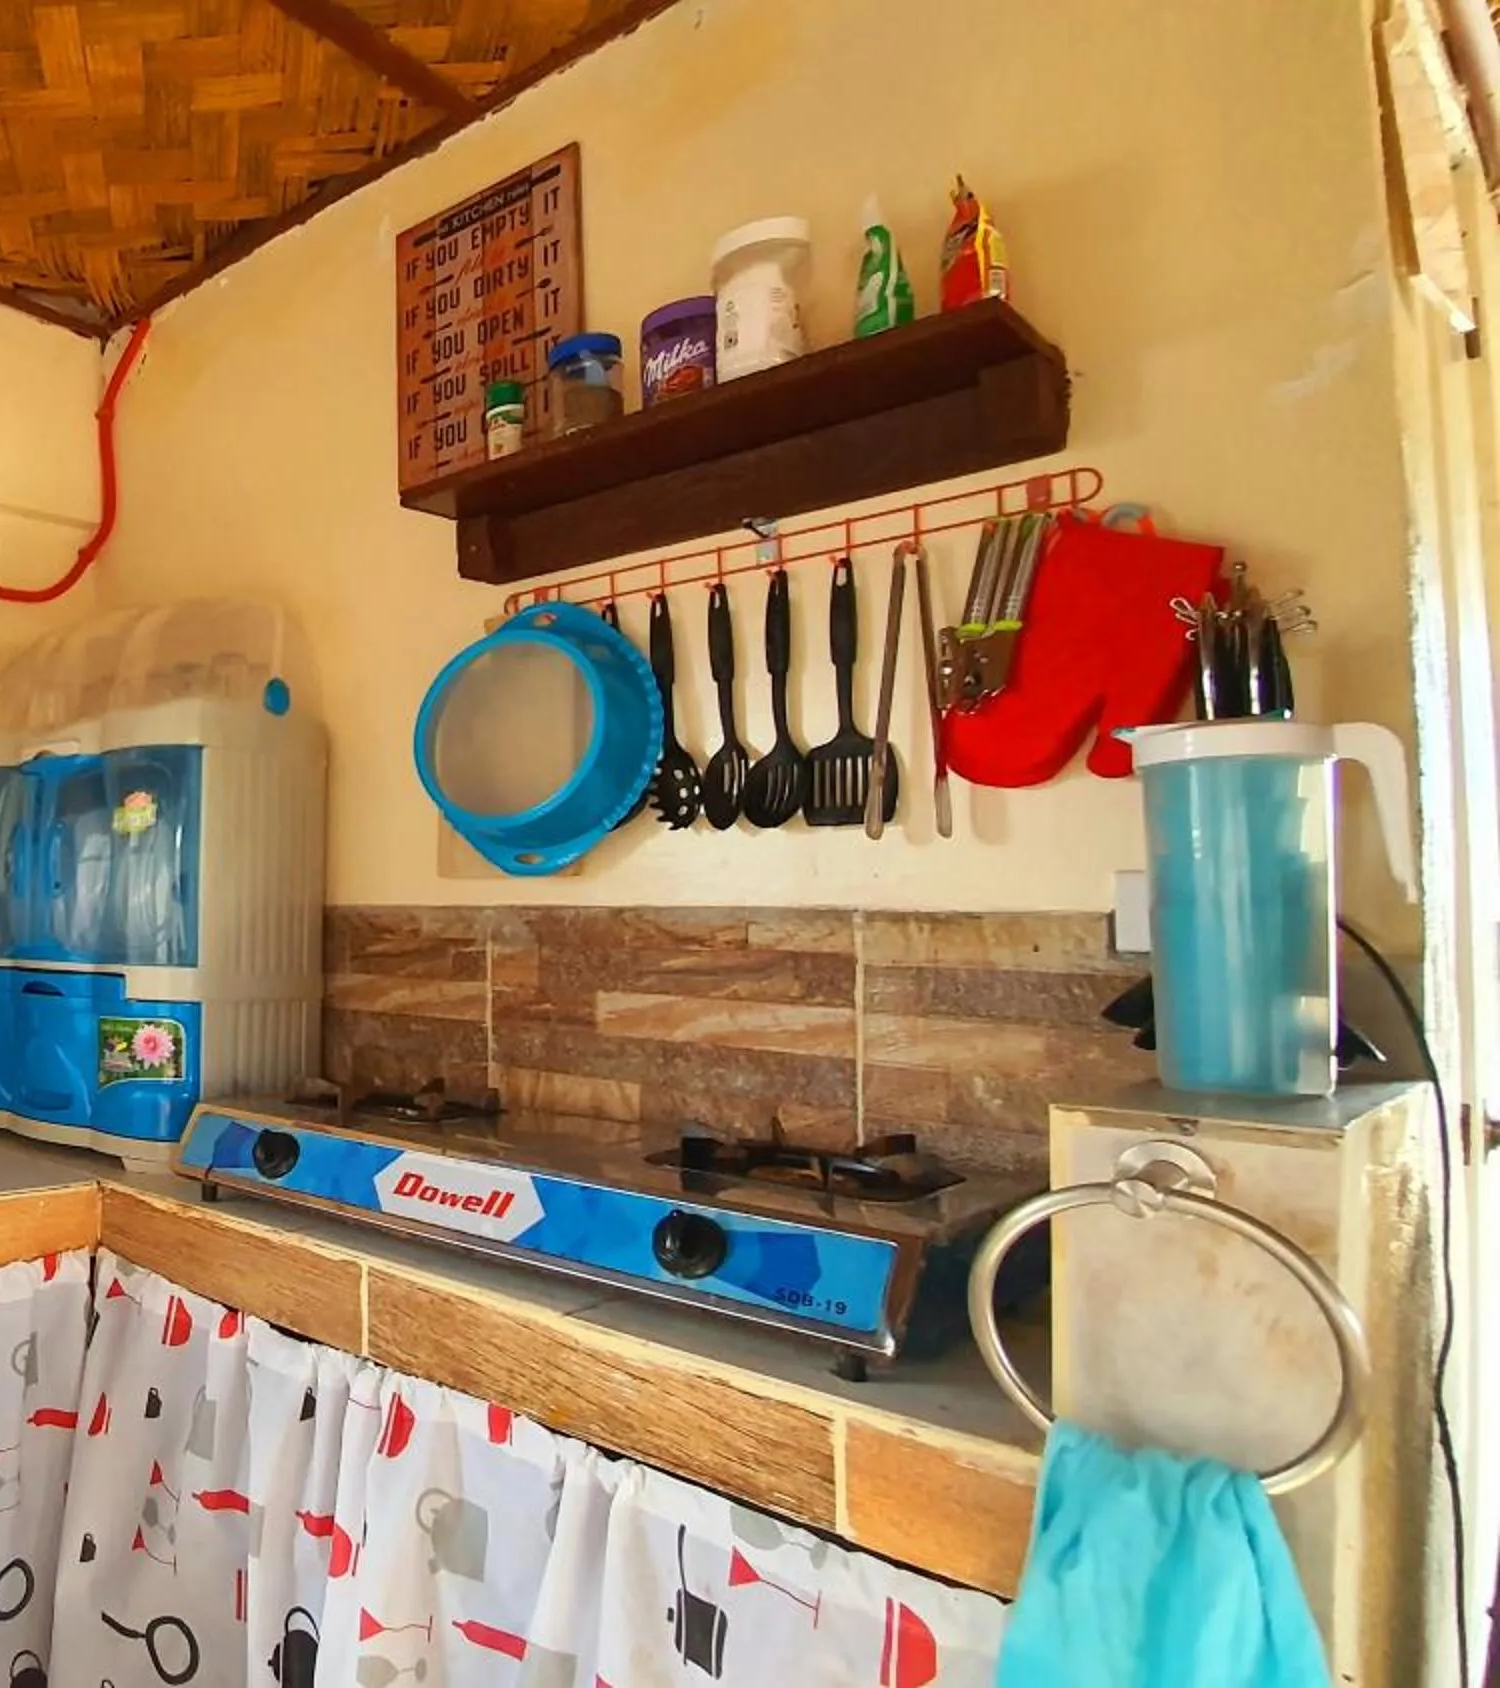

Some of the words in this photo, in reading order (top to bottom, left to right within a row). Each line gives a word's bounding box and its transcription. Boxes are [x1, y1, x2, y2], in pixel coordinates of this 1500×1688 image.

[406, 256, 419, 282] IF
[425, 238, 458, 271] YOU
[471, 200, 529, 250] EMPTY
[544, 186, 560, 214] IT
[405, 304, 419, 330] IF
[426, 287, 460, 320] YOU
[474, 255, 529, 299] DIRTY
[543, 240, 560, 268] IT
[406, 348, 419, 376] IF
[432, 330, 465, 364] YOU
[477, 303, 524, 345] OPEN
[544, 287, 560, 318] IT
[644, 337, 710, 387] Milka
[407, 391, 420, 416] IF
[433, 373, 466, 404] YOU
[479, 350, 529, 386] SPILL
[409, 435, 422, 460] IF
[434, 415, 467, 450] YOU
[393, 1172, 515, 1219] Dowell
